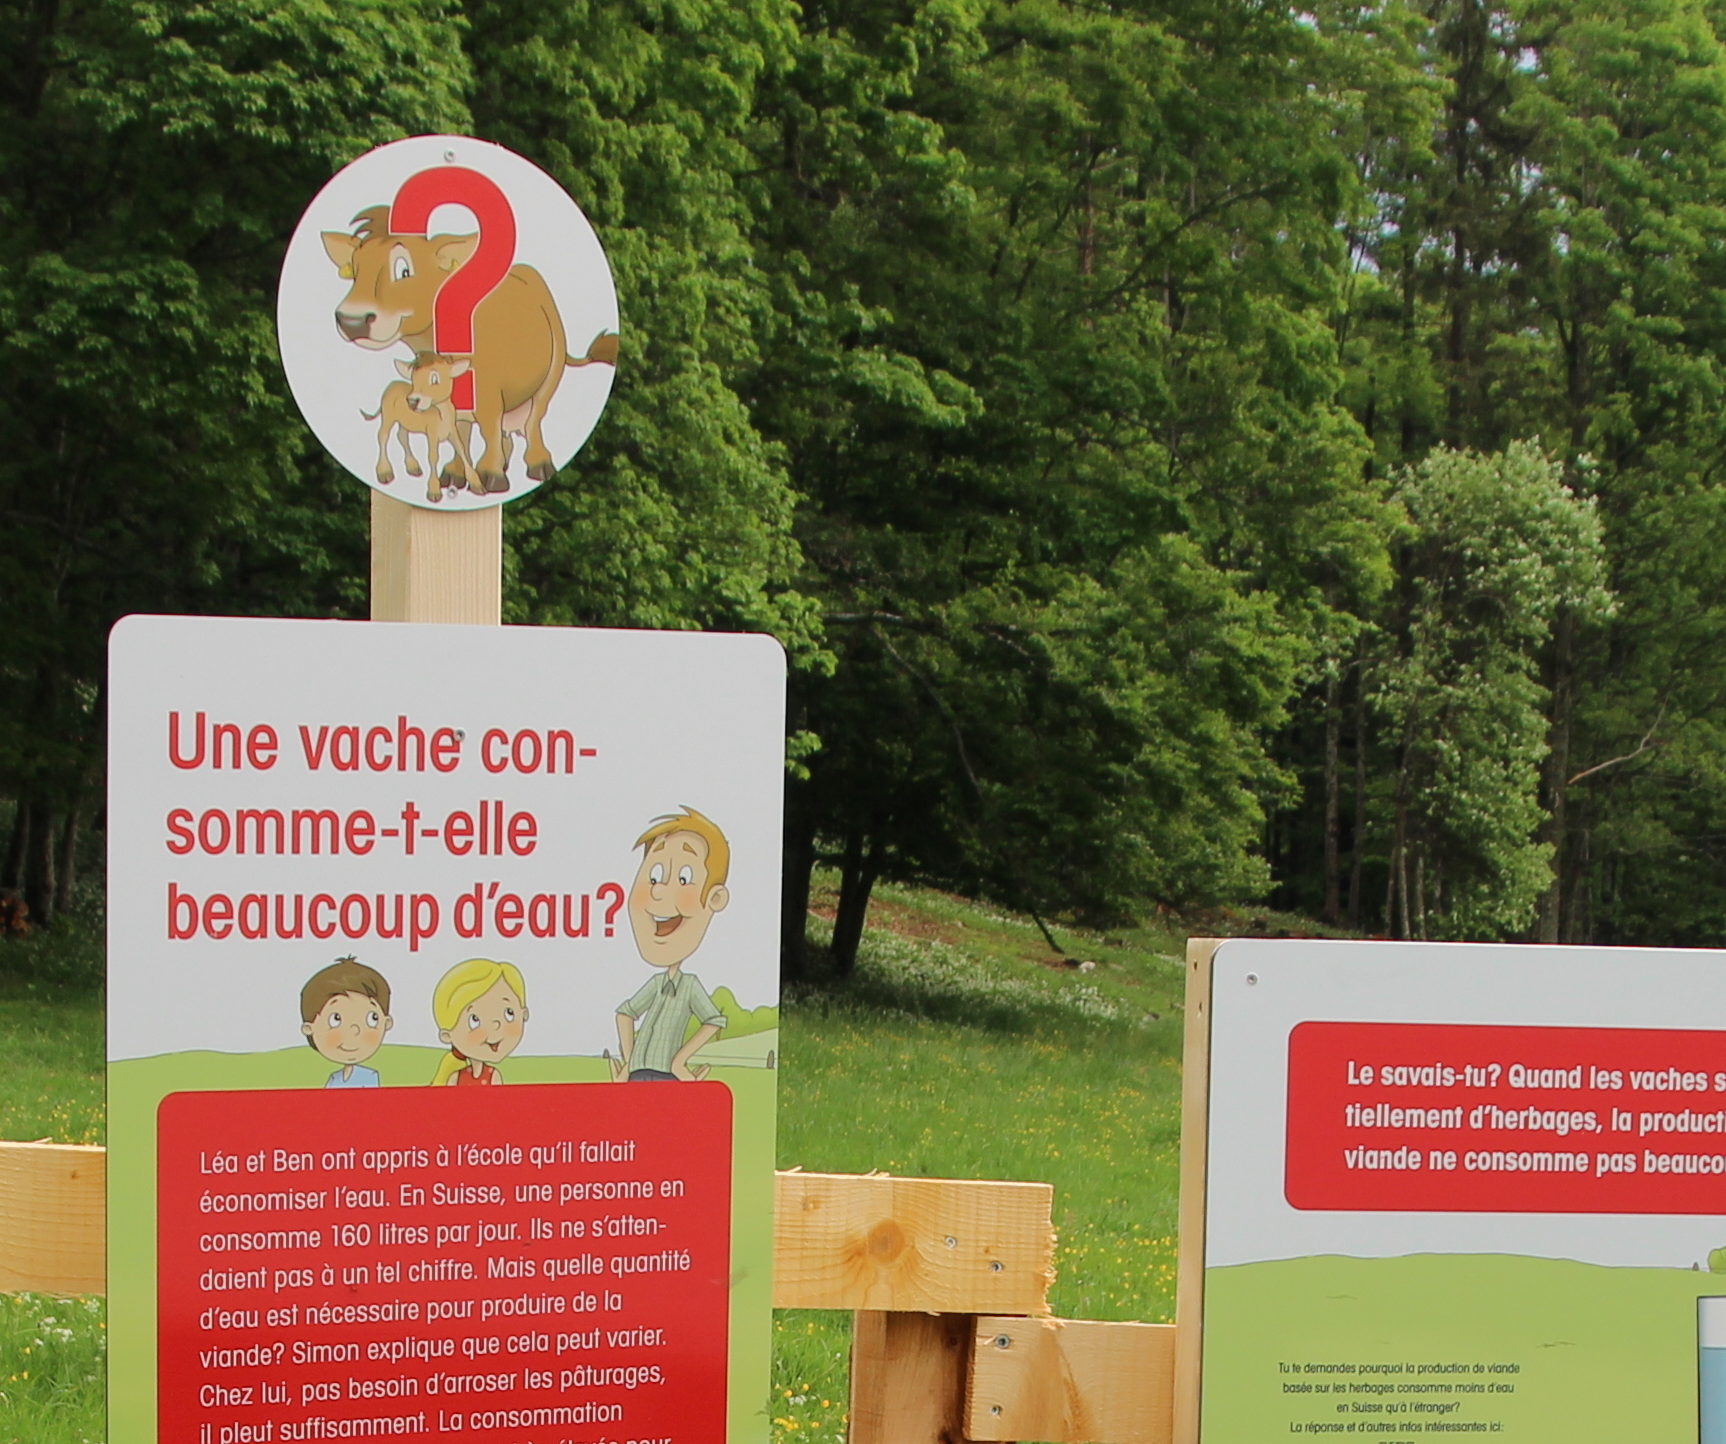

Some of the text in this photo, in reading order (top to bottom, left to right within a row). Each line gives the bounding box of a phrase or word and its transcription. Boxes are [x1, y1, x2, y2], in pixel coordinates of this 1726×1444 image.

[168, 711, 597, 775] Une vache con-
[165, 799, 538, 857] somme-t-elle
[167, 881, 625, 953] beaucoup d'eau?
[1347, 1060, 1374, 1086] Le
[1380, 1062, 1502, 1088] savais-tu?
[1508, 1063, 1582, 1090] Quand
[1589, 1065, 1623, 1090] les
[1629, 1067, 1708, 1092] vaches
[1345, 1102, 1464, 1129] tiellement
[1469, 1104, 1603, 1136] d'herbages,
[1611, 1107, 1632, 1132] la
[200, 1139, 636, 1174] Léa et Ben ont appris à l'école qu'il fallait
[1344, 1145, 1422, 1170] viande
[1428, 1150, 1457, 1171] ne
[1464, 1151, 1589, 1173] consomme
[1595, 1153, 1637, 1178] pas
[199, 1214, 667, 1253] consomme 160 litres par jour. Ils ne s'atten-
[1278, 1361, 1521, 1376] Tu te demandes pourquoi la production de viande
[1282, 1382, 1313, 1394] basée
[1314, 1383, 1331, 1394] sur
[1332, 1382, 1347, 1394] les
[1348, 1382, 1395, 1396] herbages
[1396, 1383, 1453, 1394] consomme
[1454, 1382, 1486, 1394] moins
[1336, 1403, 1350, 1414] en
[1351, 1401, 1384, 1413] Suisse
[1289, 1421, 1302, 1433] La
[1304, 1421, 1345, 1435] réponse
[1346, 1422, 1357, 1433] et
[1398, 1421, 1423, 1433] infos
[1424, 1421, 1488, 1433] intéressantes
[1489, 1421, 1504, 1433] ici:
